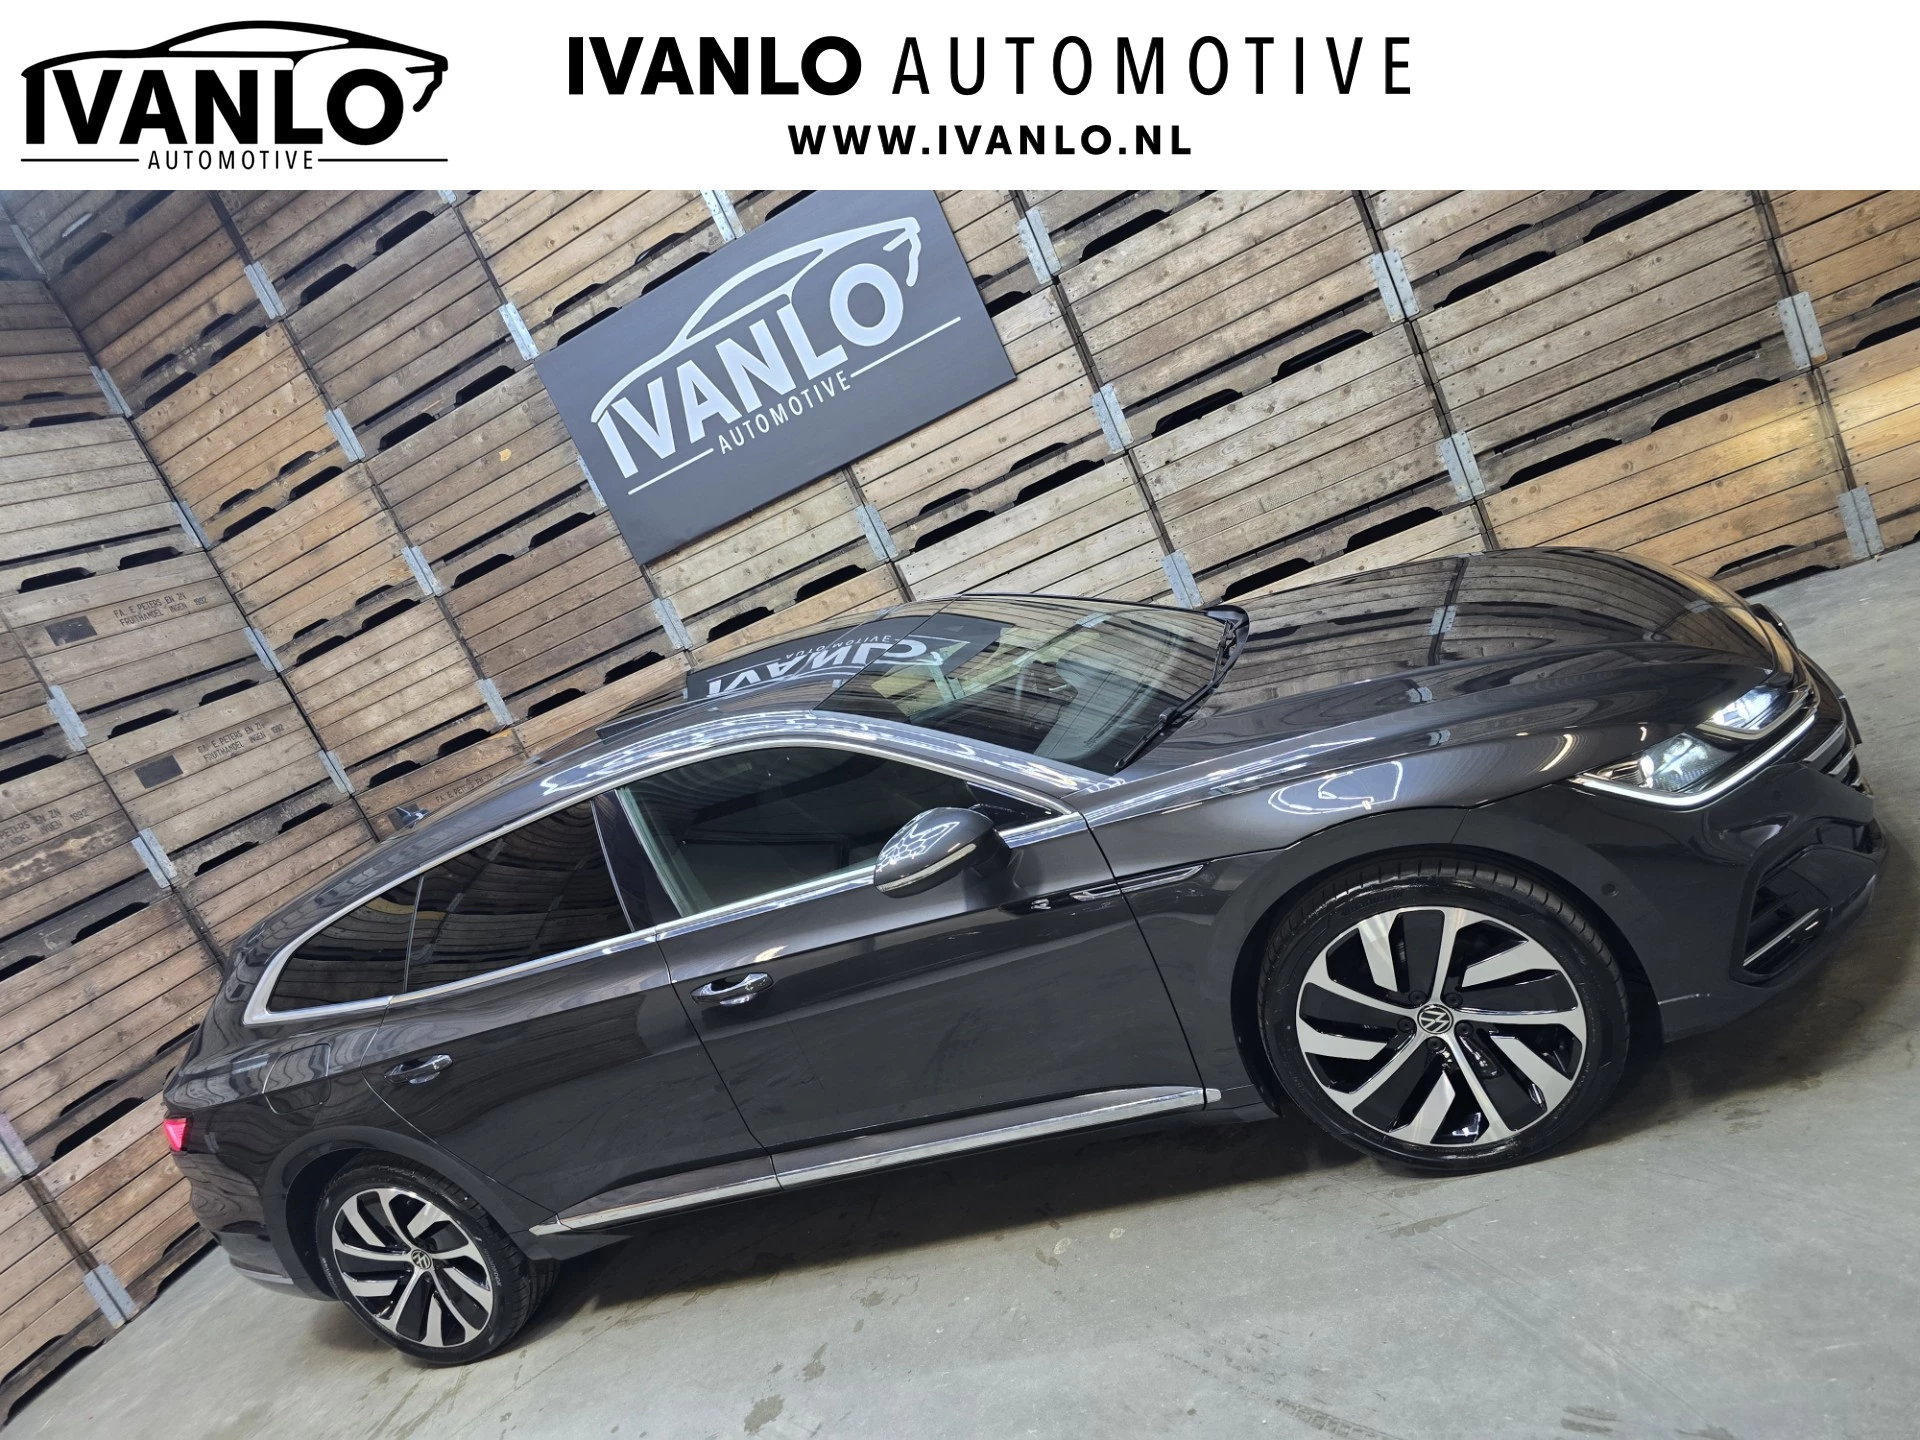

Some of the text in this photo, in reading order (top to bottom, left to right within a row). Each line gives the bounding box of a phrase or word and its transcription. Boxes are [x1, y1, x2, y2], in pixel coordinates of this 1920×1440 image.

[597, 263, 904, 479] IVANLO
[719, 370, 851, 455] AUTOMOTIVE
[136, 598, 162, 611] PETERS
[164, 595, 175, 604] EN
[120, 608, 164, 626] FRUITHANDEL
[219, 730, 243, 744] PETERS
[244, 726, 254, 734] EN
[203, 741, 244, 761] FRUITHANDEL
[48, 807, 62, 819] ZN
